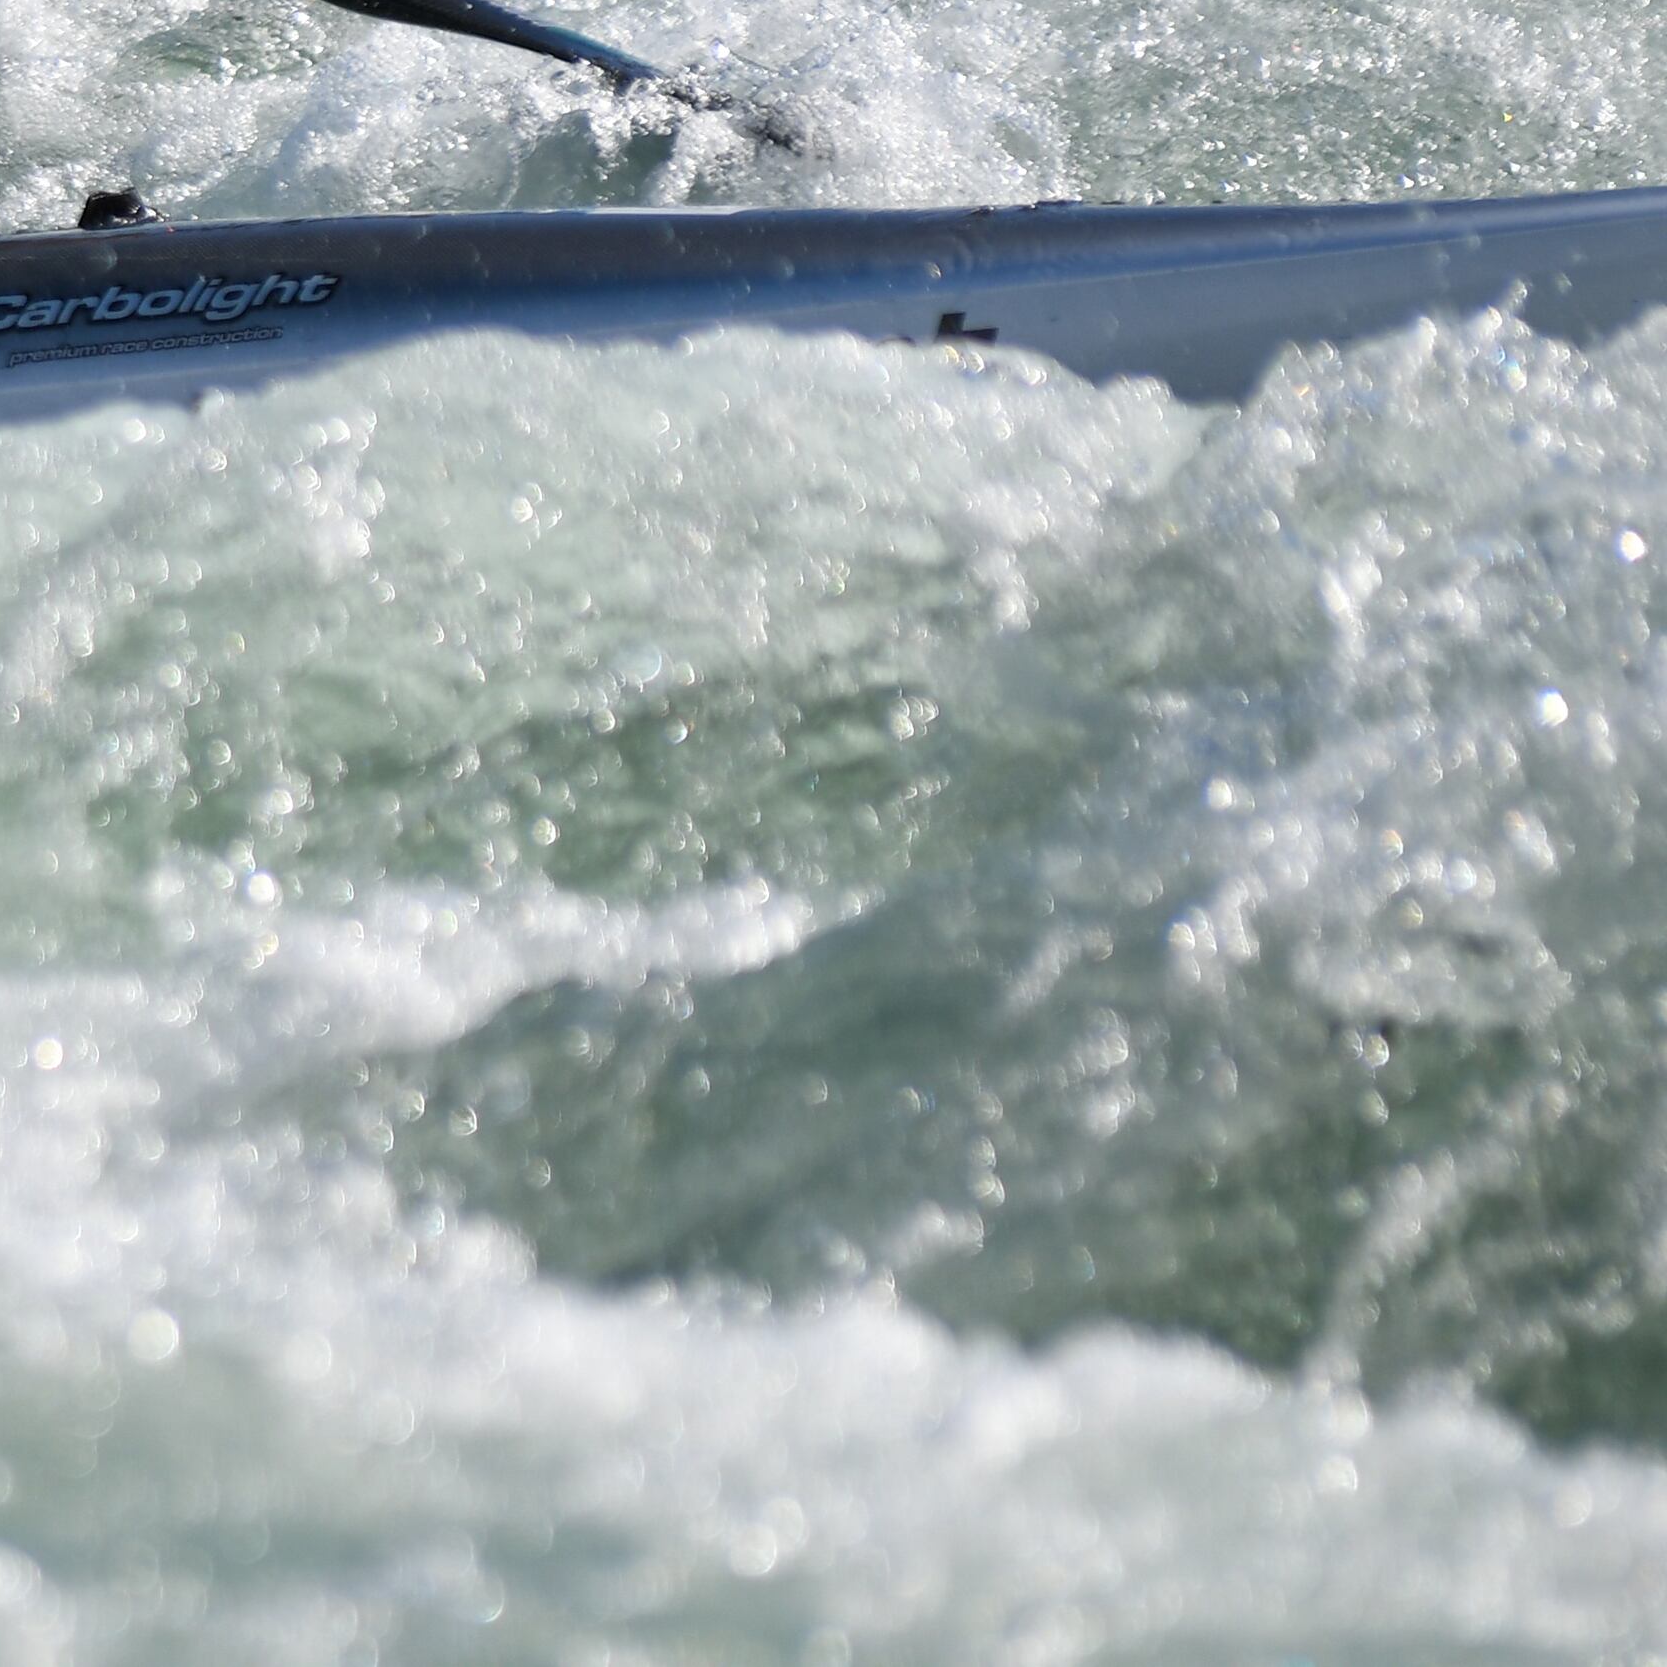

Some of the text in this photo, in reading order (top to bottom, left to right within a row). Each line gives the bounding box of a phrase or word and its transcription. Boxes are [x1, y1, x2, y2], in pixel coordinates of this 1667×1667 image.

[6, 326, 284, 368] premium race construction
